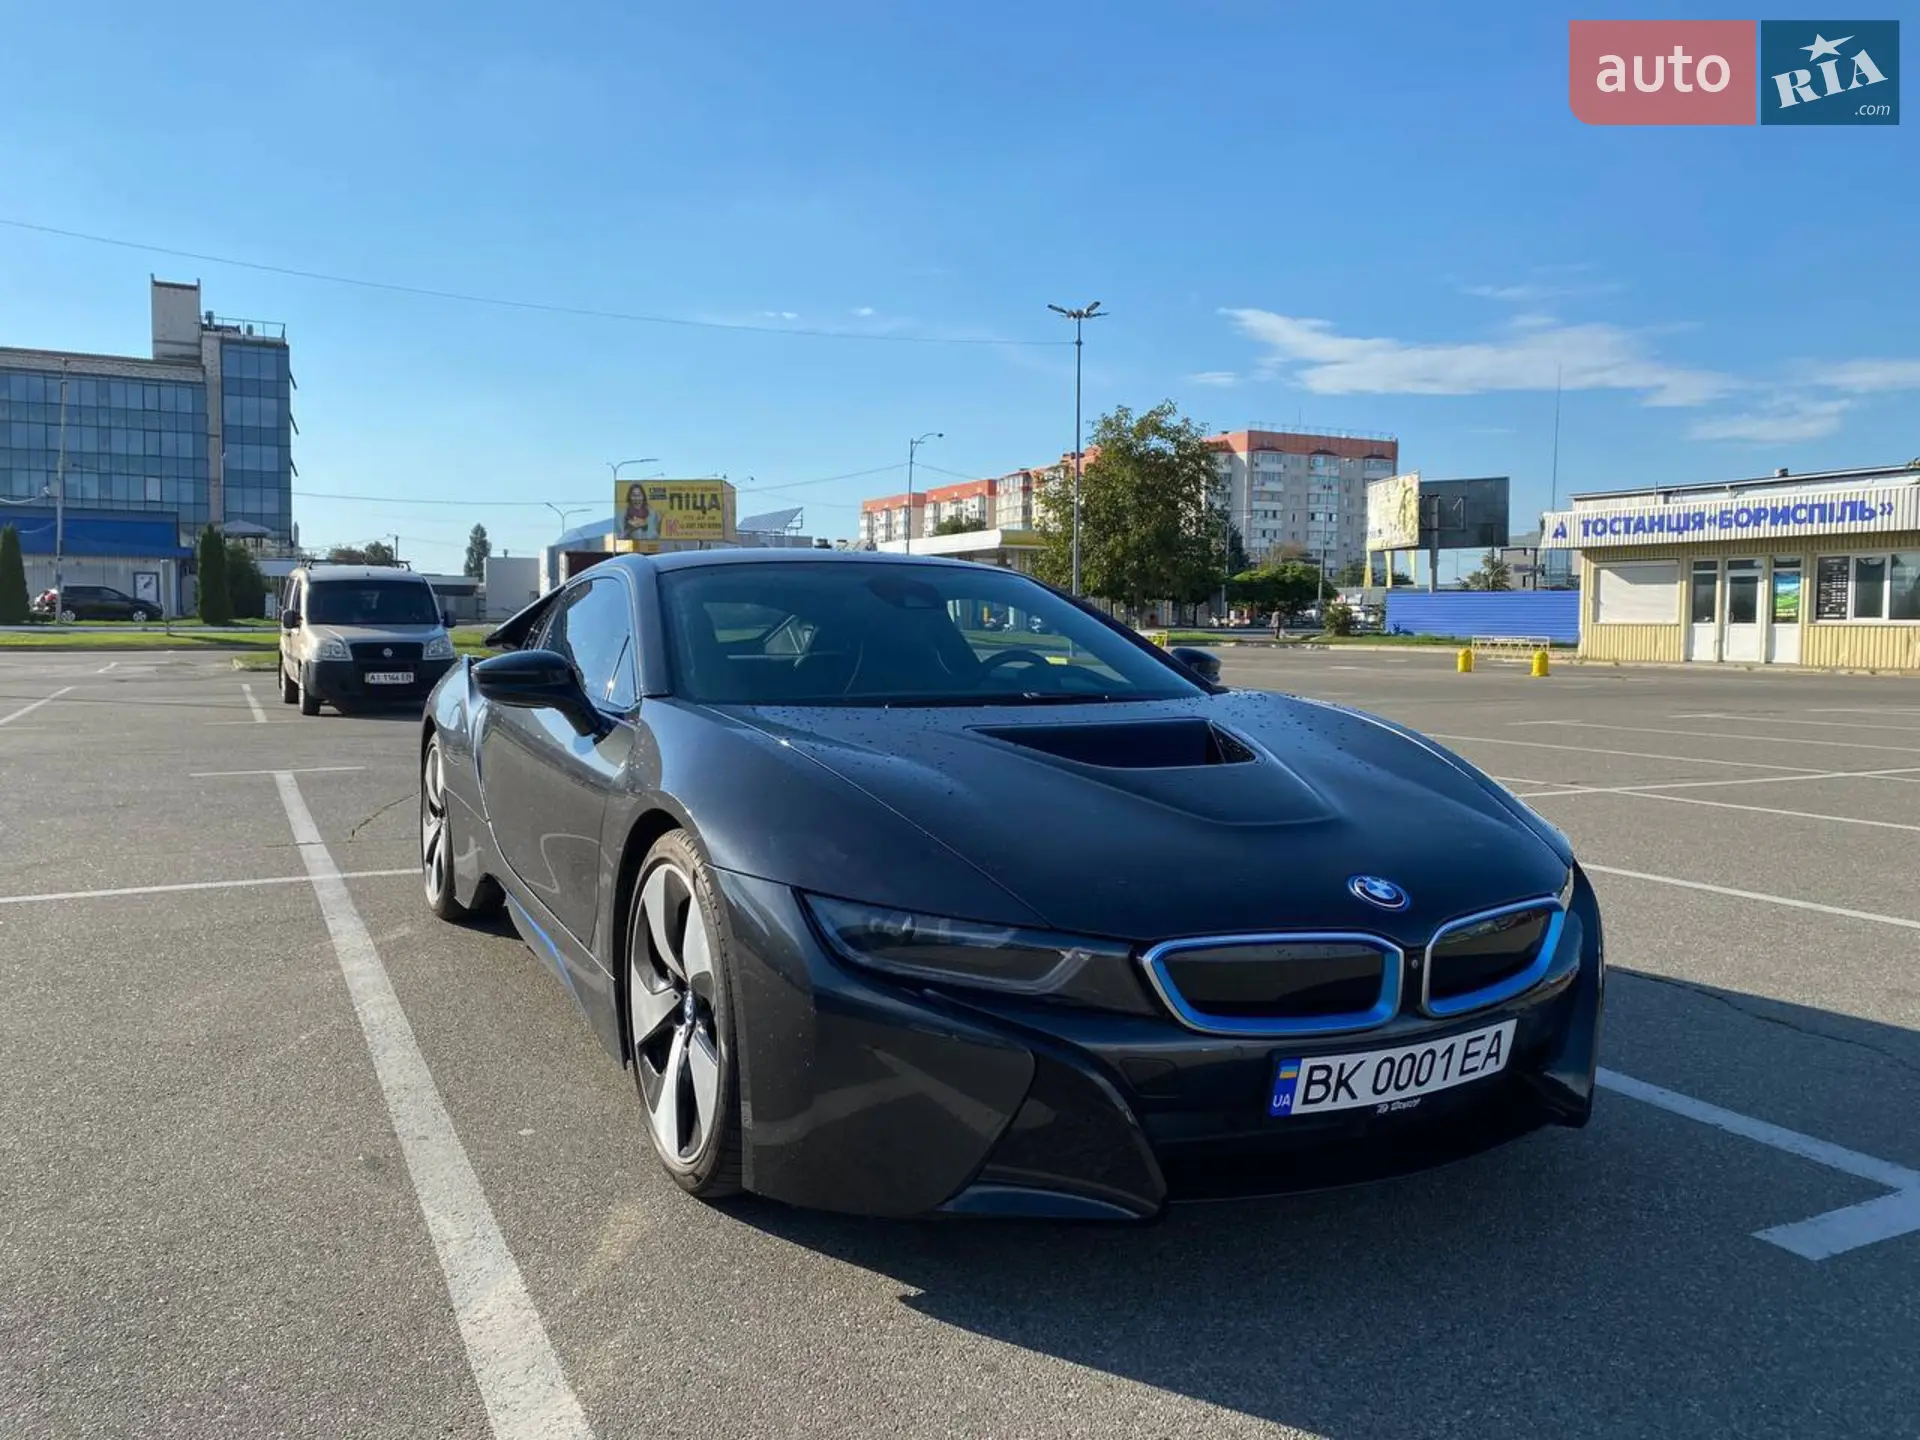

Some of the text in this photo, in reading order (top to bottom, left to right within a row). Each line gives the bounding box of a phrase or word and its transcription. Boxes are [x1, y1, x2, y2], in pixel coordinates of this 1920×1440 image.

[669, 492, 721, 515] ПІЦА
[1301, 1029, 1504, 1106] BK 0001 EA
[1272, 1093, 1291, 1108] UA
